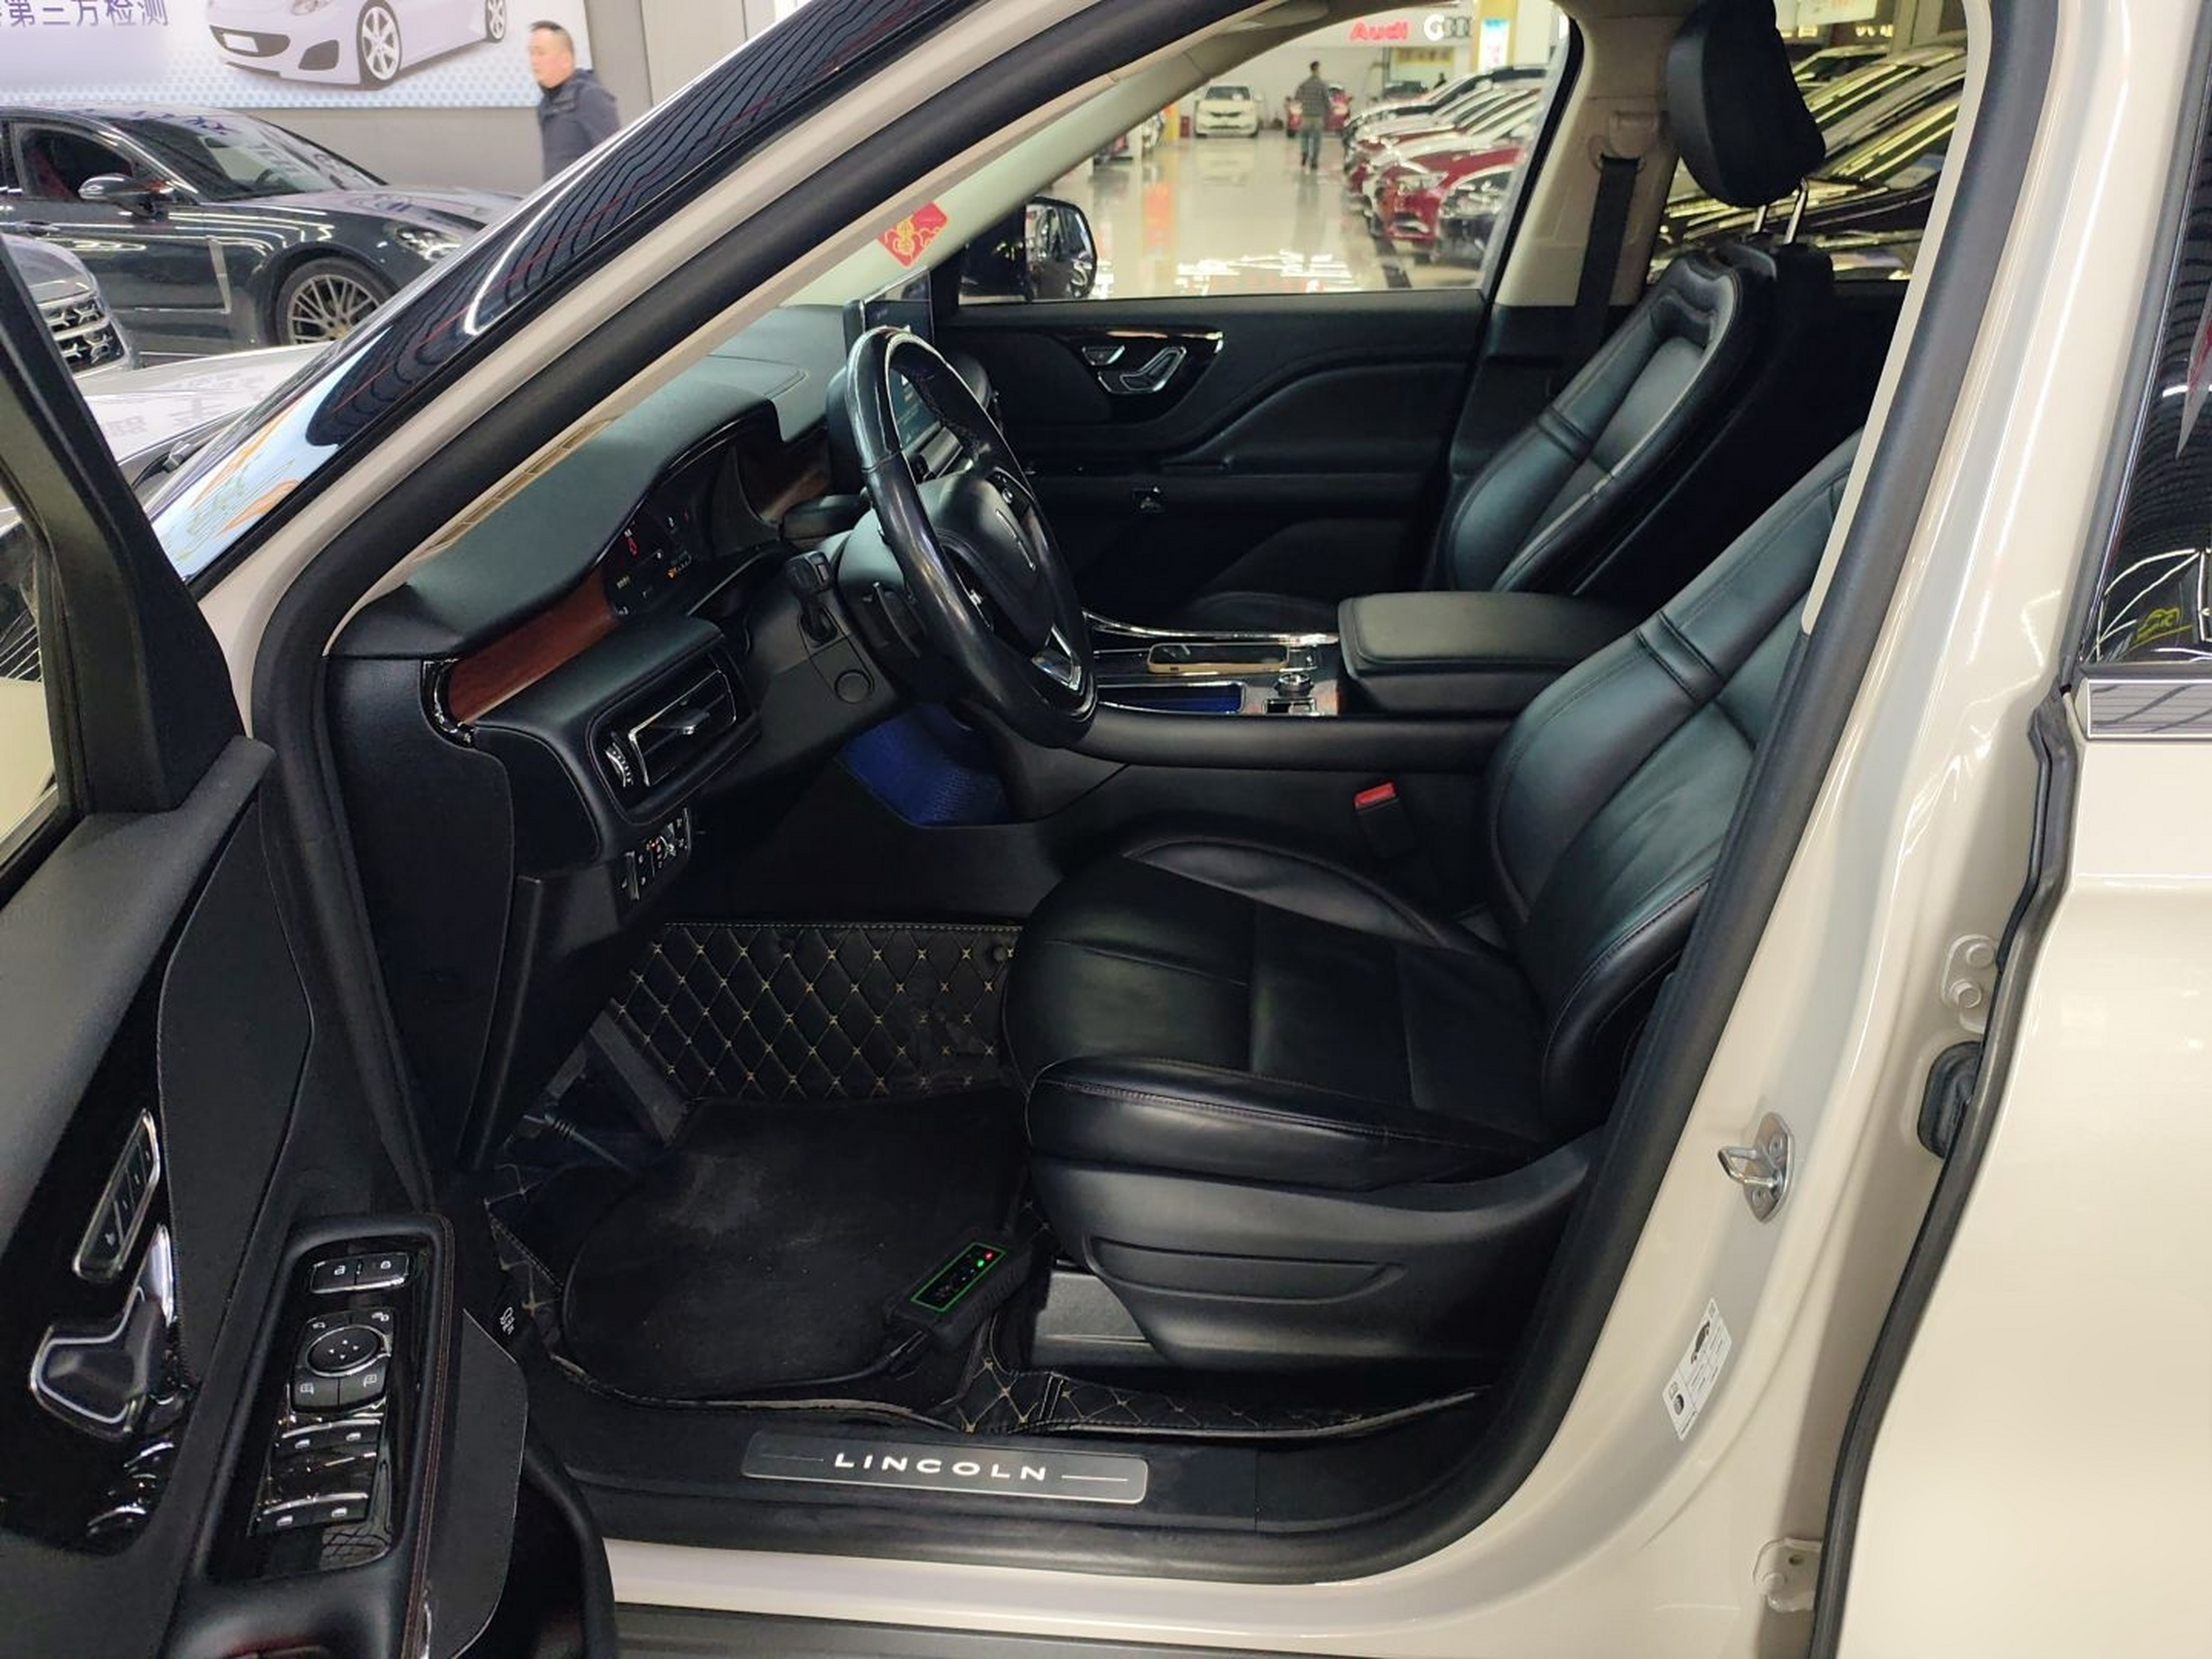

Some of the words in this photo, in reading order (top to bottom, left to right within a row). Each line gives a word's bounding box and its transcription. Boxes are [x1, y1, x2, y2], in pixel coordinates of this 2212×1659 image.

[0, 0, 169, 27] 第三方检测
[1350, 20, 1408, 40] Audi
[834, 1452, 1048, 1482] LINCOLN
